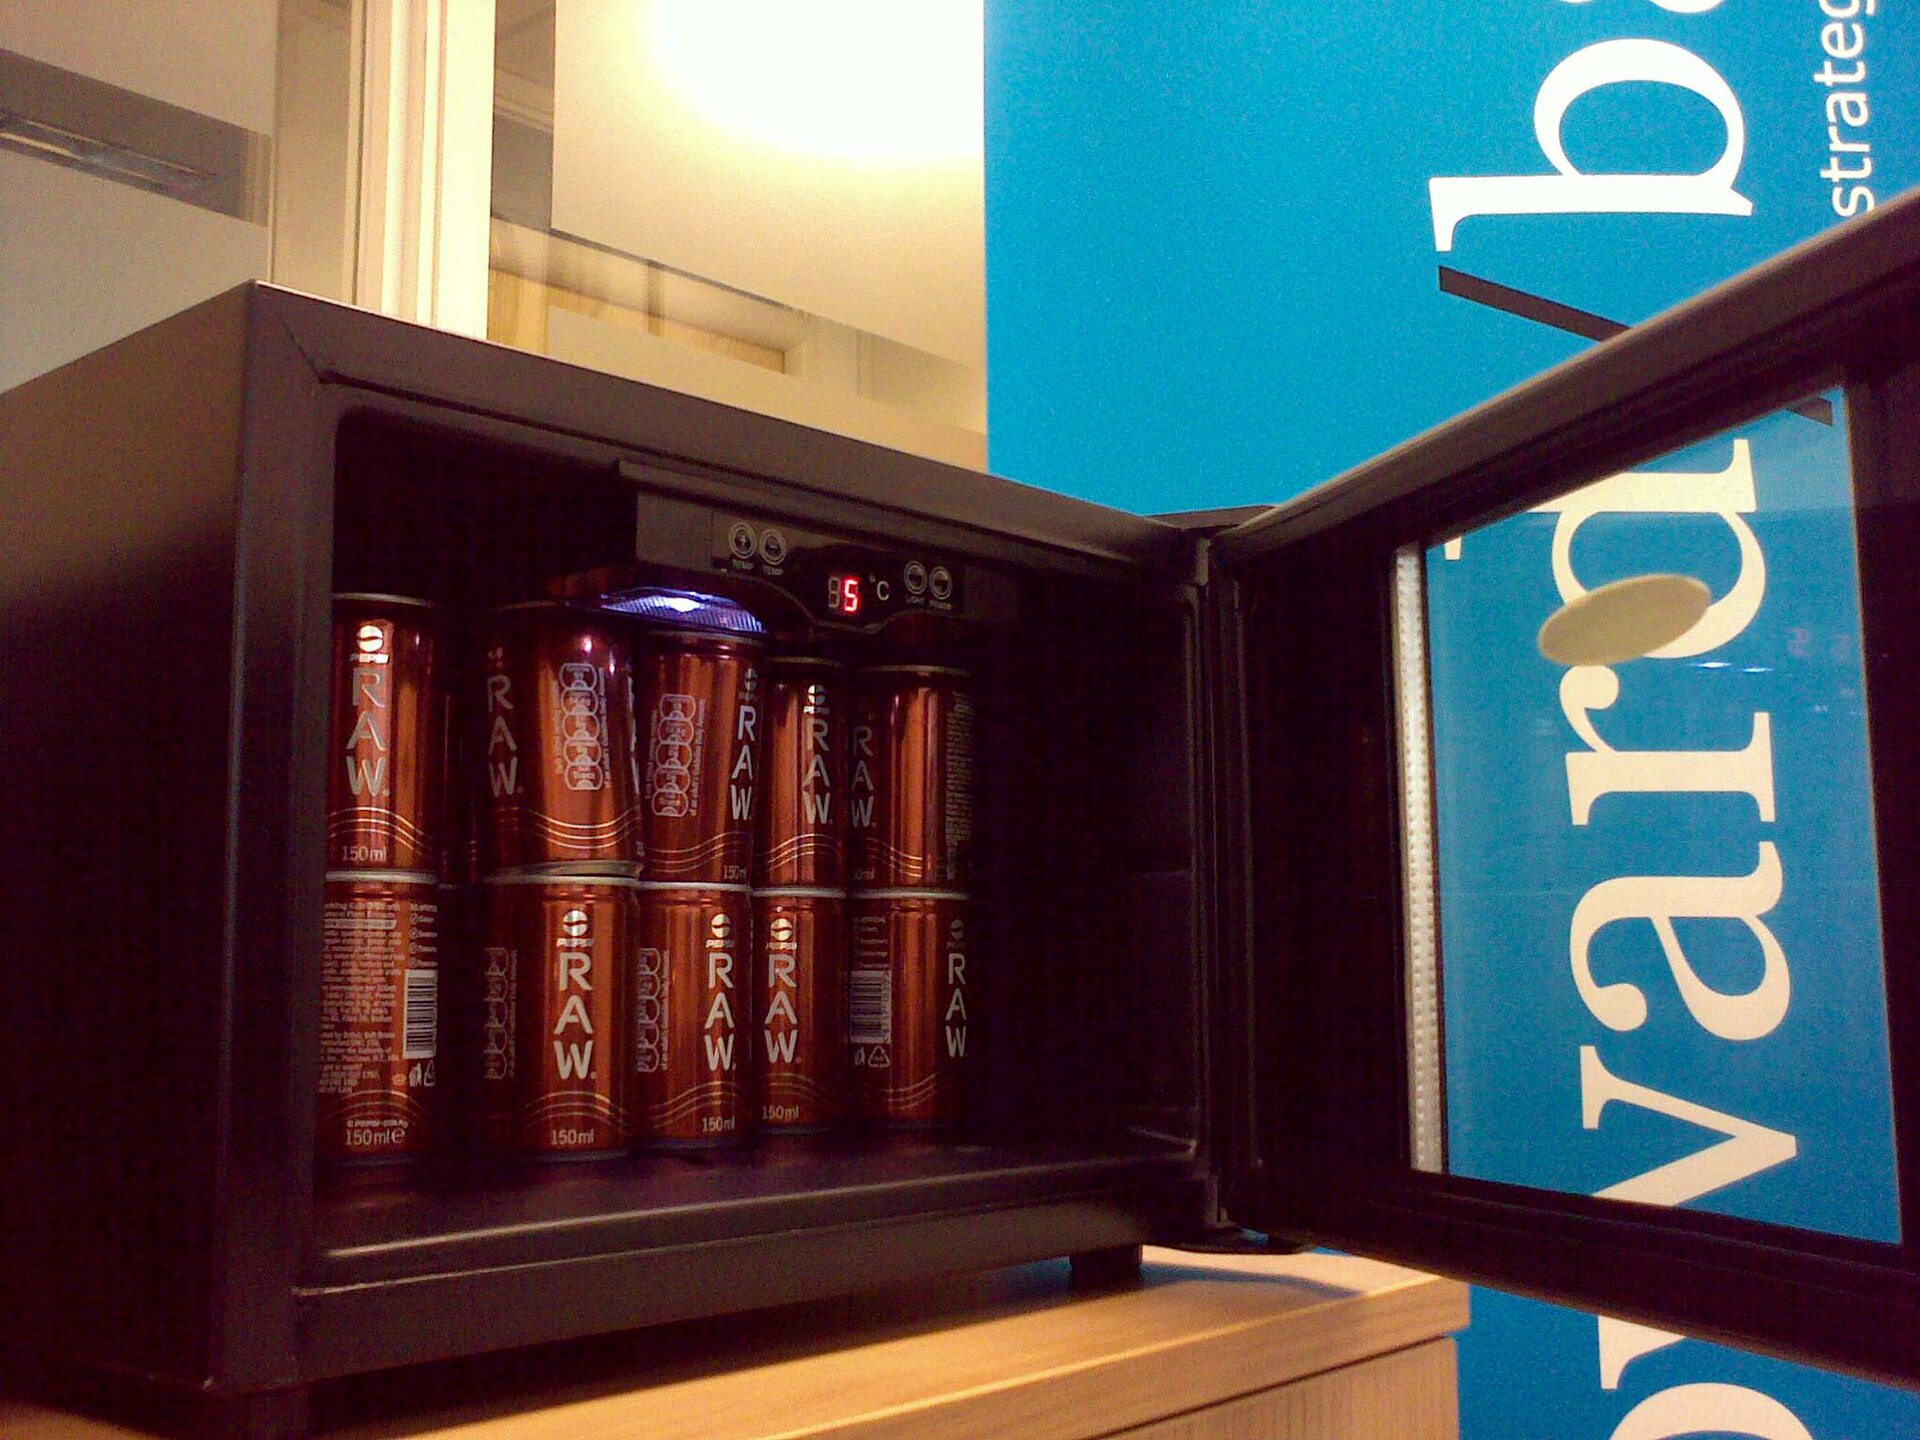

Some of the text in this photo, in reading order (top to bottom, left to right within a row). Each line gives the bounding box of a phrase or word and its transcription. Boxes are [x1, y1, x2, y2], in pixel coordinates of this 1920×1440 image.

[761, 1104, 800, 1122] 150ml
[702, 1116, 736, 1133] 150ml
[551, 1127, 595, 1146] 150ml
